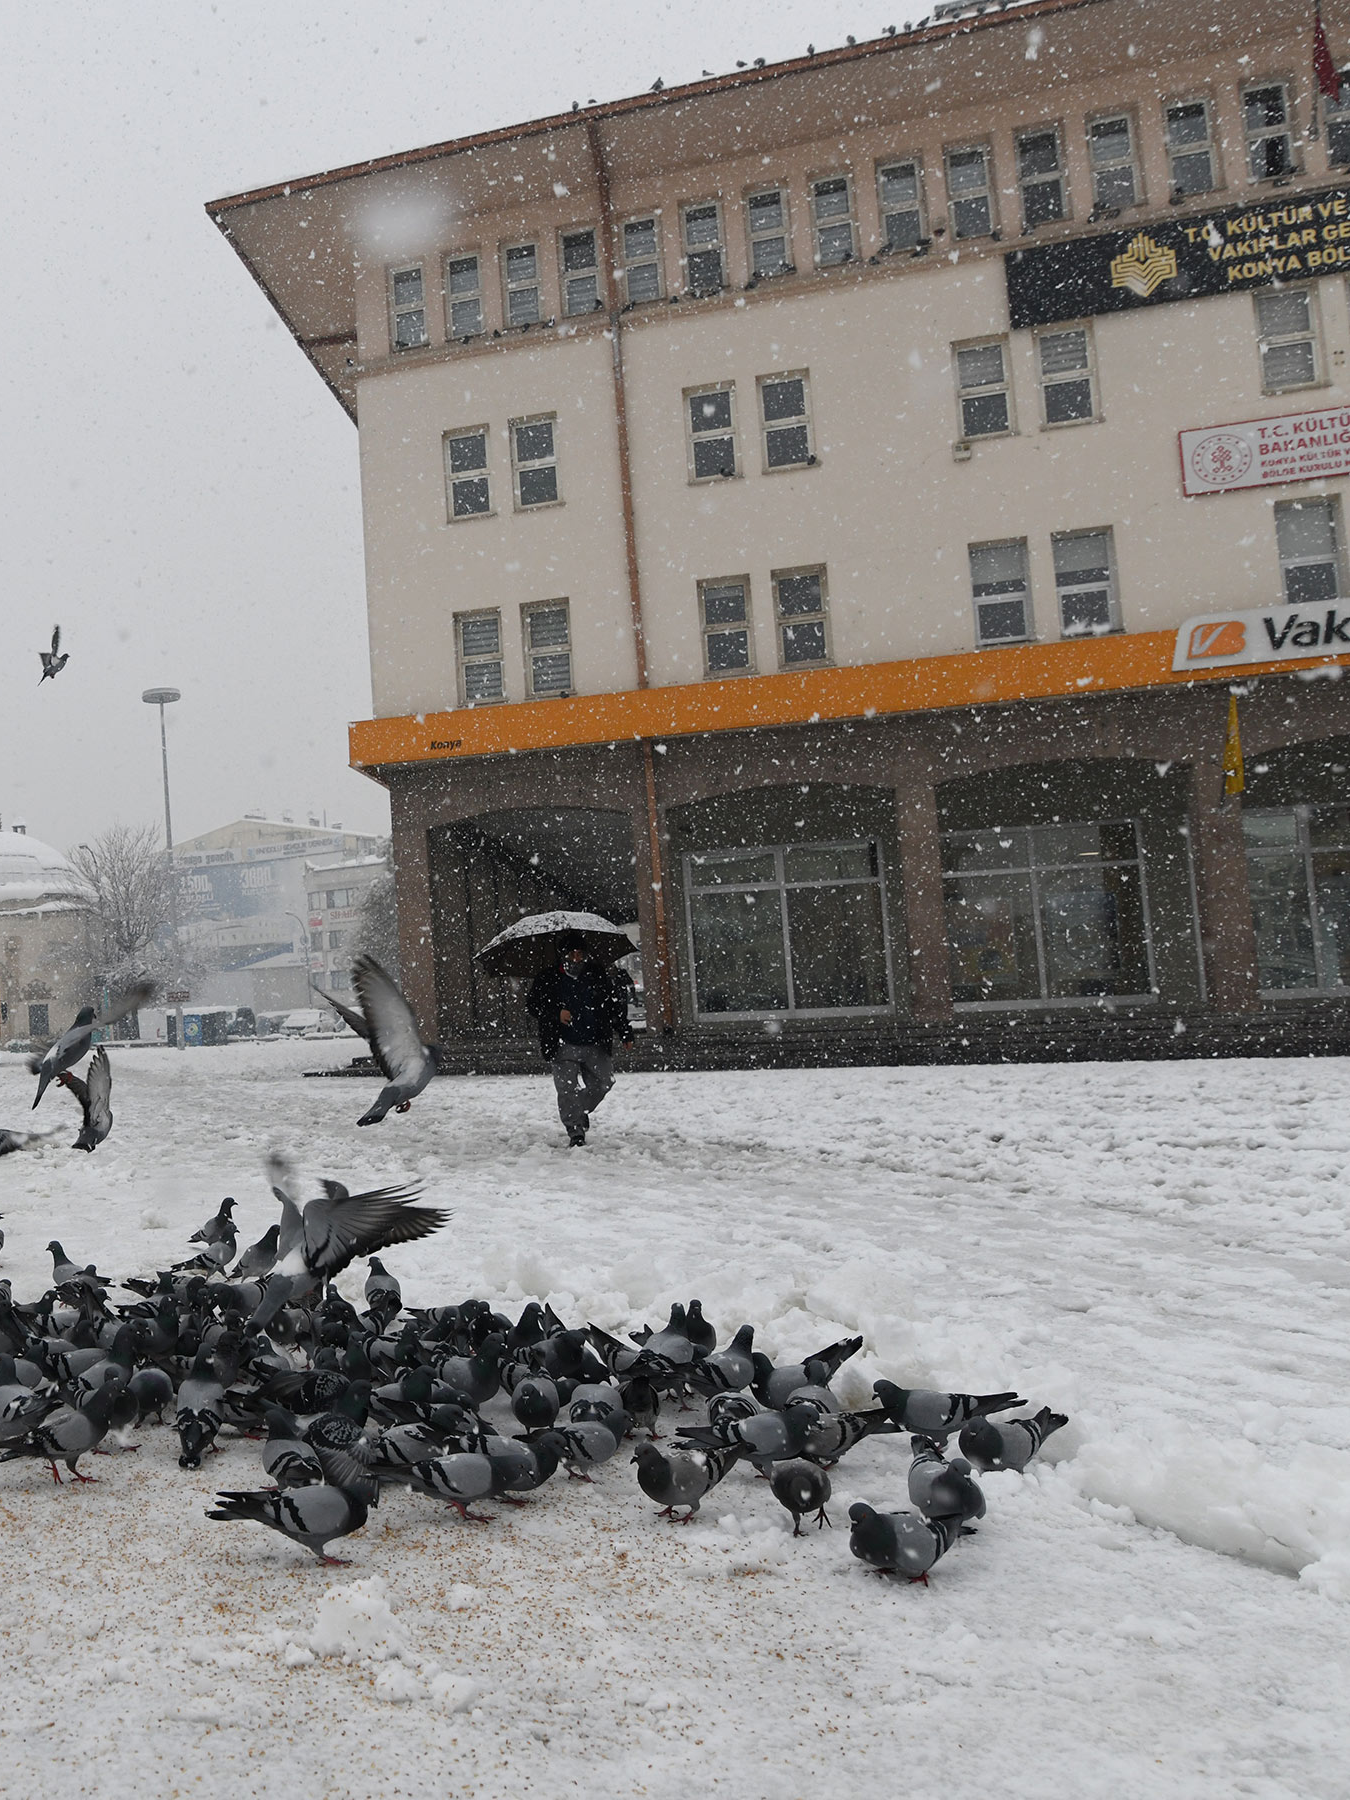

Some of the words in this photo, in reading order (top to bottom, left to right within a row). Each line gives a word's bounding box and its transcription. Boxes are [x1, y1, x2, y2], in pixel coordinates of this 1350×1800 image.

[1226, 205, 1313, 236] KÜLTÜR
[1318, 199, 1348, 218] VE
[1207, 228, 1317, 261] VAKIFLAR
[1227, 254, 1302, 281] KONYA
[1257, 425, 1289, 439] T.C.
[1262, 611, 1350, 651] Vak
[430, 739, 462, 750] Konya
